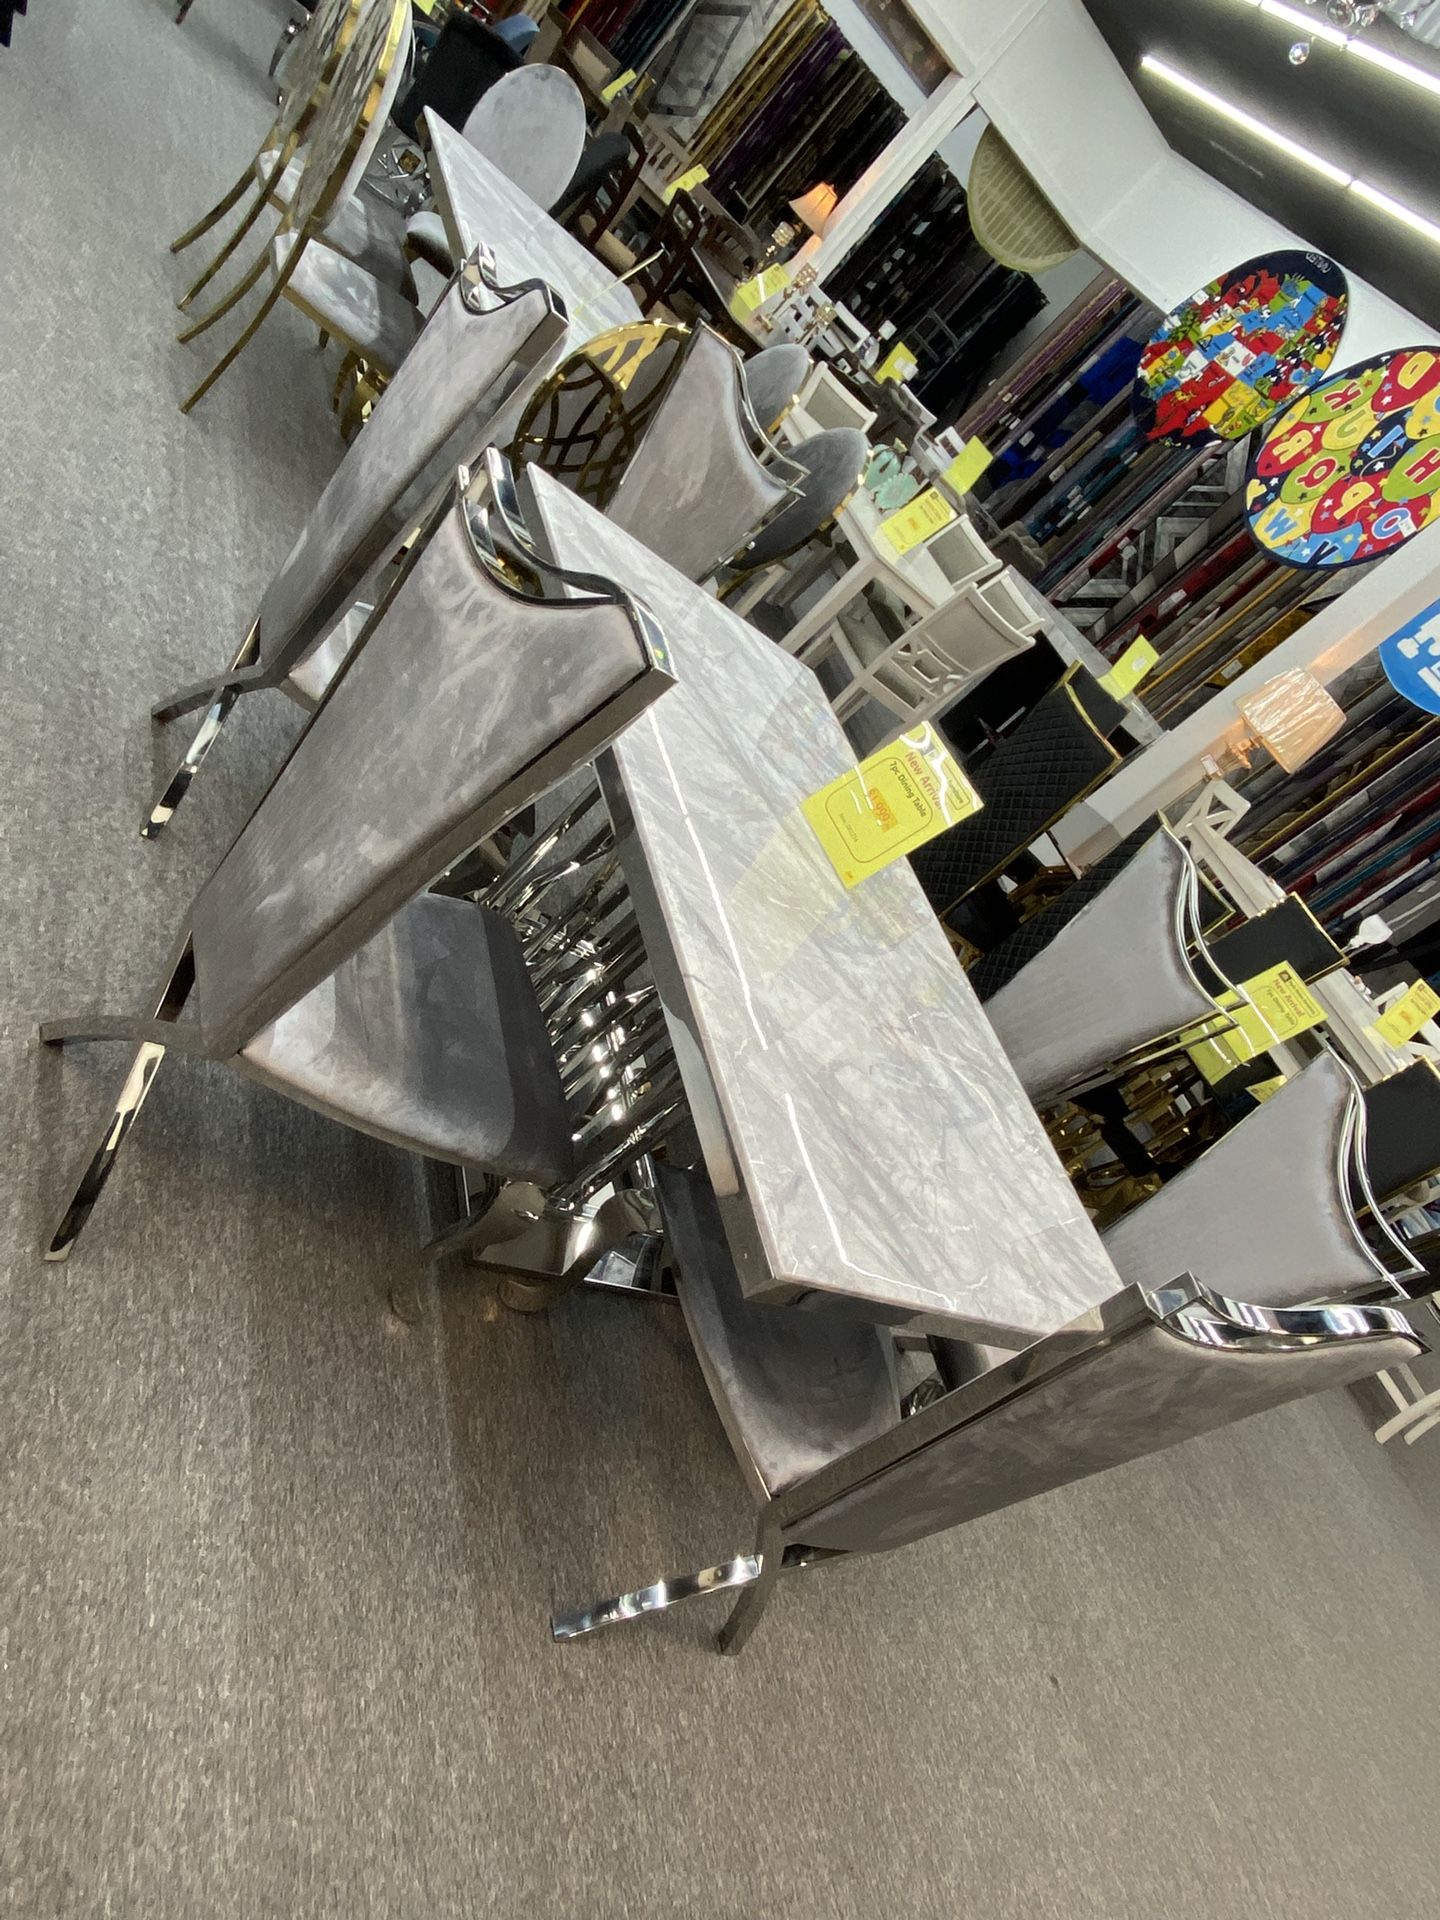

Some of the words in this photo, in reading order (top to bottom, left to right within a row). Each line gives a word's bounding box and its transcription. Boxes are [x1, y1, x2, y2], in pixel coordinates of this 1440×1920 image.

[889, 760, 901, 776] 7pc
[898, 773, 915, 799] Dining
[912, 797, 927, 818] Table
[904, 751, 924, 776] New
[920, 775, 943, 811] Arriva
[1284, 994, 1306, 1018] Arrival
